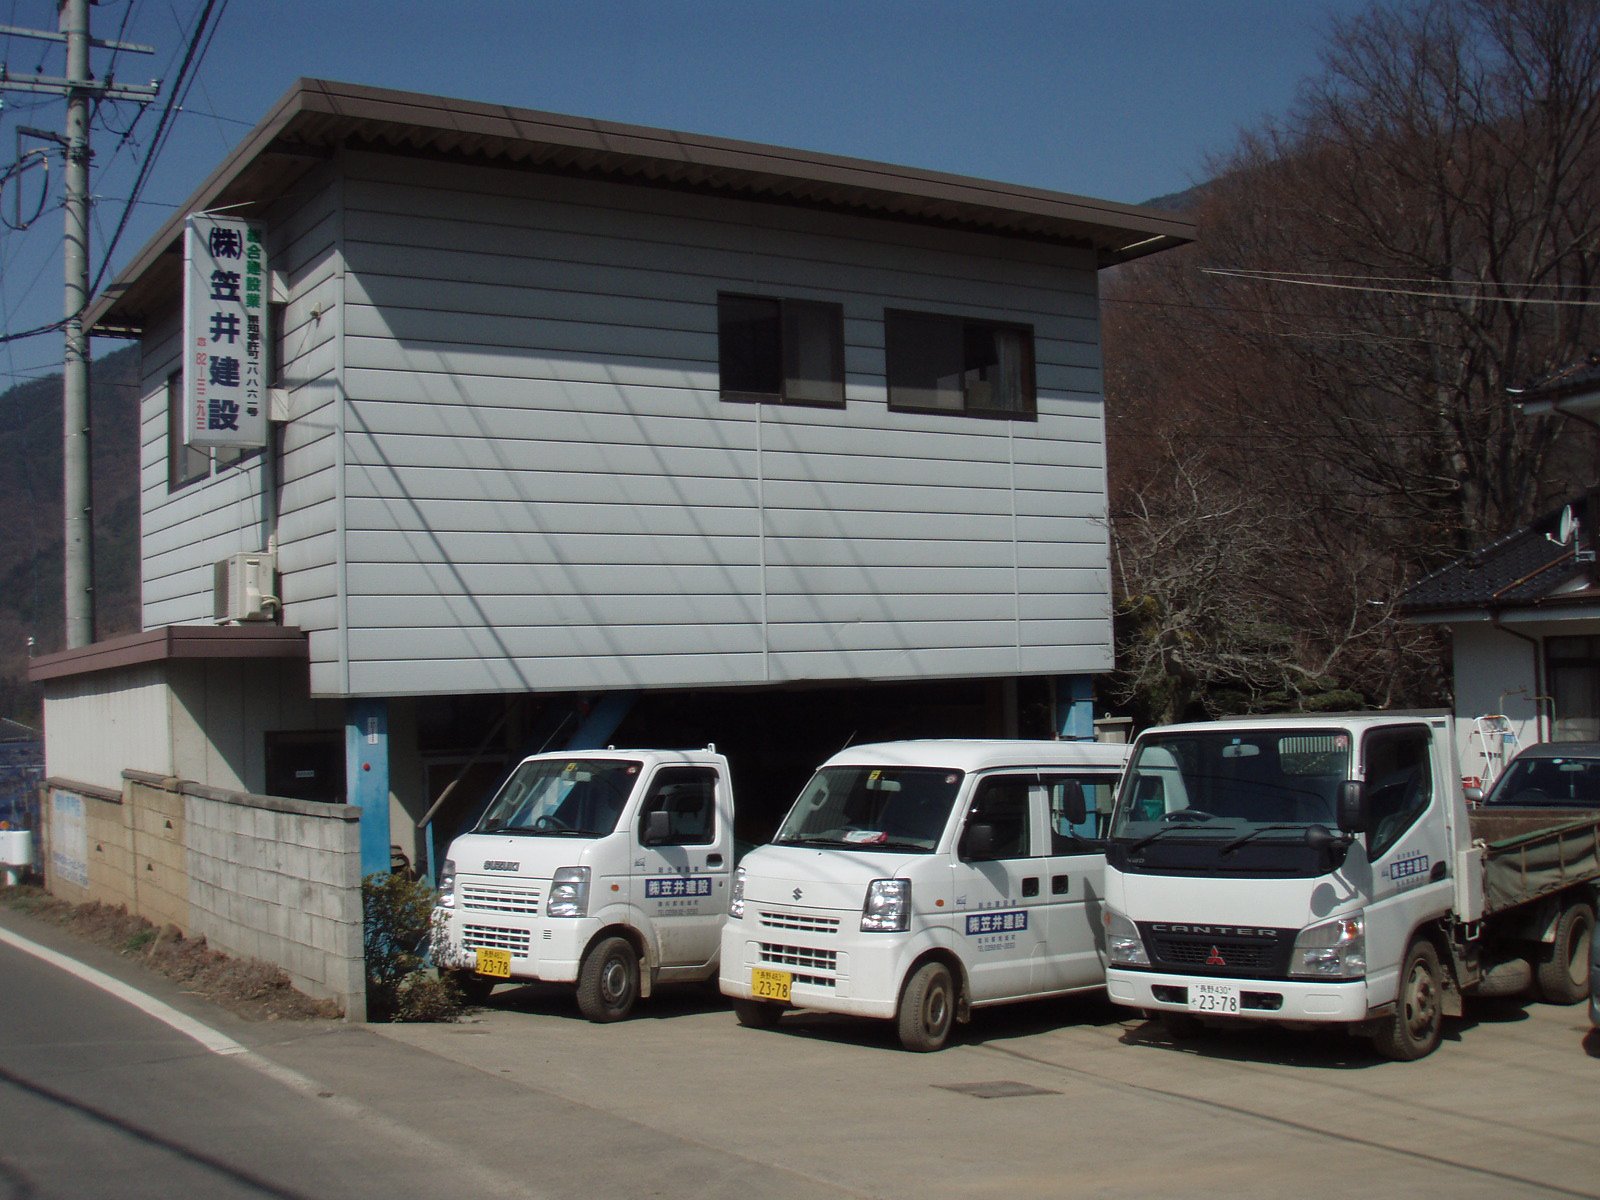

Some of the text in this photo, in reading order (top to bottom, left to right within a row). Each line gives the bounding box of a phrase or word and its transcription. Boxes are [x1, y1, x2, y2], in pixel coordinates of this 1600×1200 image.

[484, 860, 520, 872] SUZUKI
[1152, 924, 1277, 937] CANTER
[483, 959, 508, 975] 23-78
[759, 981, 788, 998] 23-78
[1199, 994, 1237, 1012] 23-78
